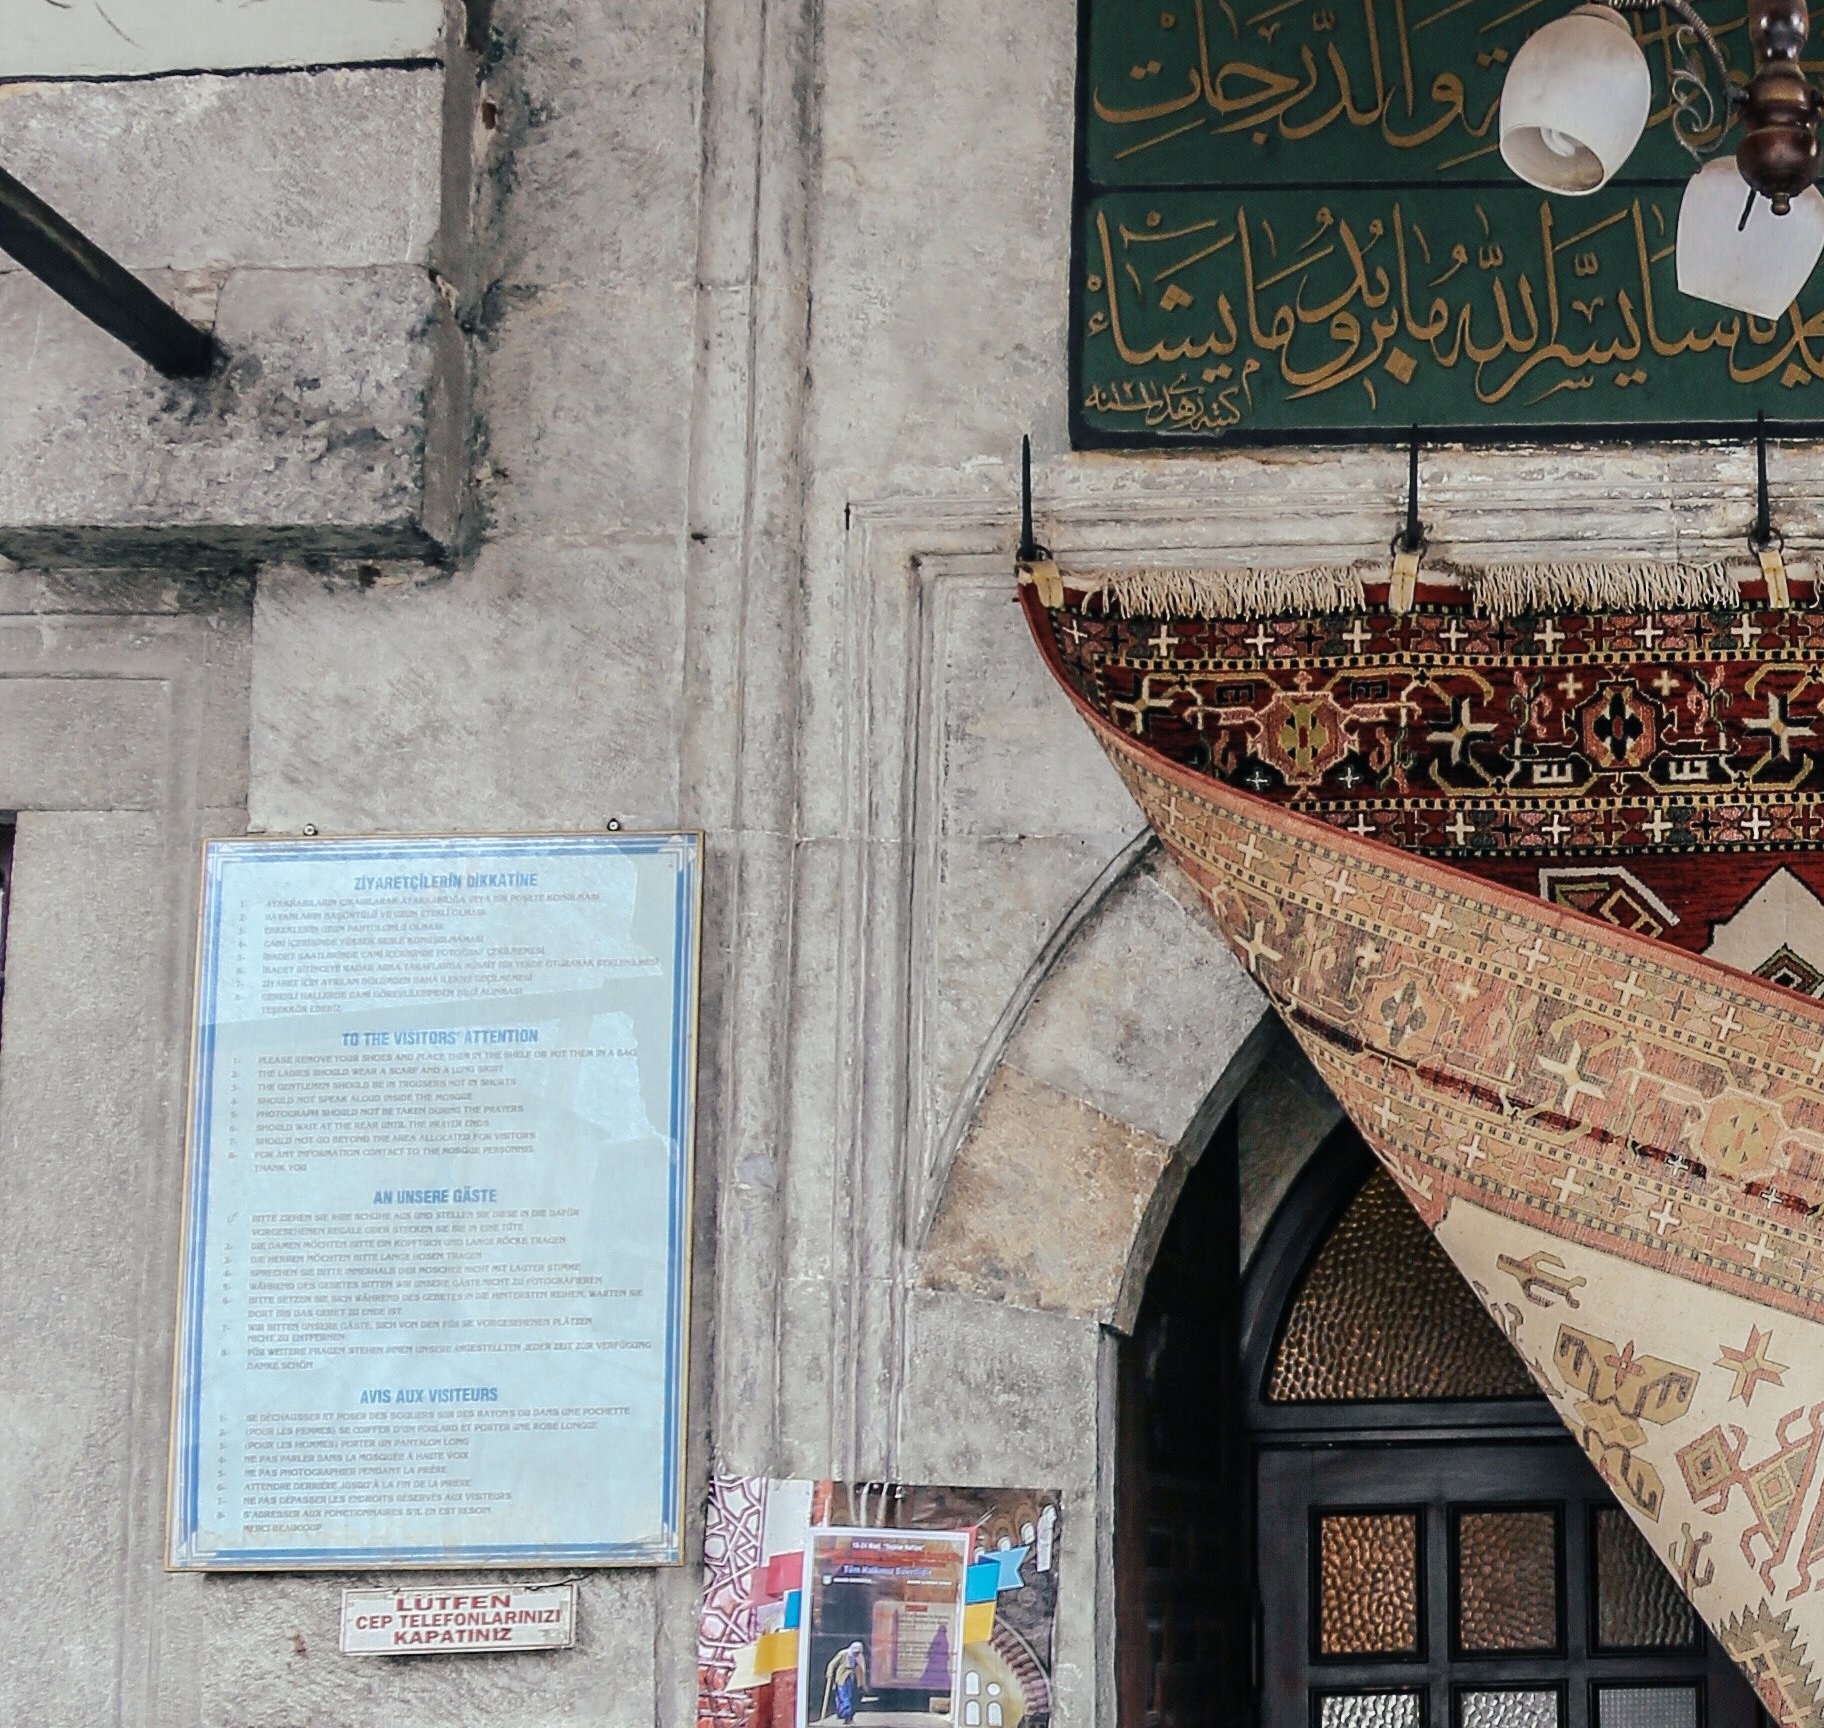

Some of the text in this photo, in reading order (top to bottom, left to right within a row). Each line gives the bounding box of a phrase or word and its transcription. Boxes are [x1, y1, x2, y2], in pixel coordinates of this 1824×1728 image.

[467, 871, 538, 888] DİKKATİNE
[342, 1032, 358, 1046] TO
[364, 1032, 389, 1046] THE
[464, 1029, 538, 1044] ATTENTION
[374, 1186, 497, 1204] AN UNSERE GÄSTE
[360, 1387, 498, 1404] AVIS AUX VISITEURS
[396, 1594, 511, 1612] LÜTFEN
[355, 1609, 561, 1630] CEP TELEFONLARINIZI
[394, 1628, 512, 1645] KAPATINIZ
